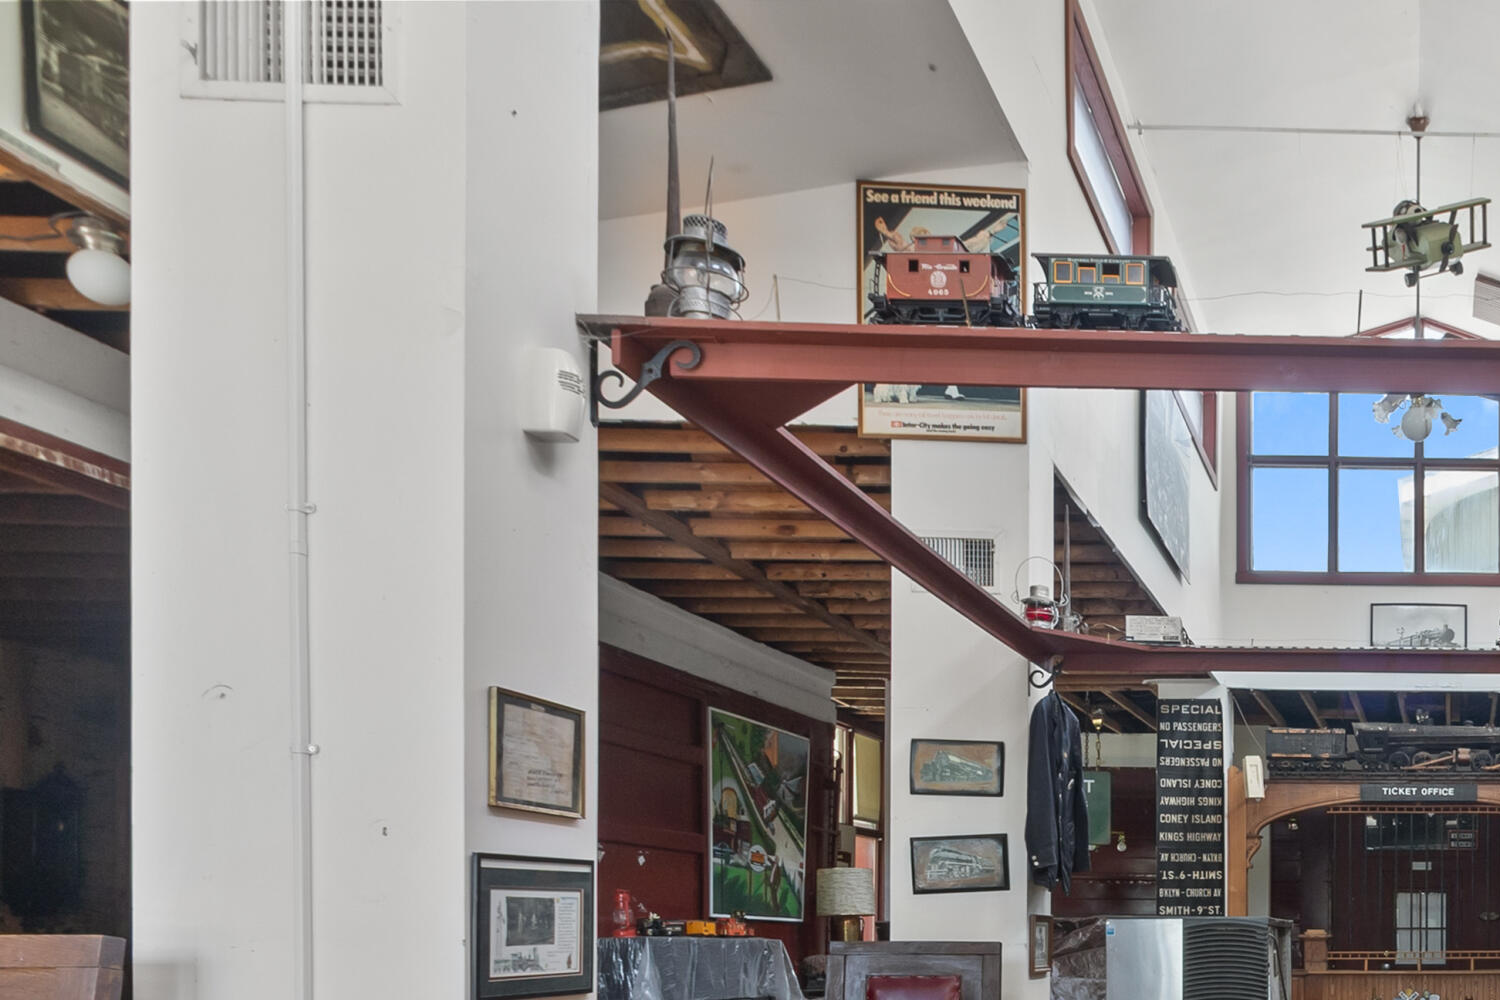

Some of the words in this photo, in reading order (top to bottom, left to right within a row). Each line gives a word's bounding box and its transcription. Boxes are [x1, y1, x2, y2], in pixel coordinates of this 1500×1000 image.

[866, 190, 889, 203] See
[891, 194, 899, 203] a
[901, 190, 937, 204] friend
[939, 192, 961, 206] this
[963, 195, 1016, 209] weekend
[1160, 704, 1222, 714] SPECIAL
[1160, 722, 1170, 732] NO
[1173, 722, 1222, 732] PASSENGERS
[1160, 740, 1222, 750] SPECIAL
[1160, 757, 1209, 767] PASSENGERS
[1212, 757, 1222, 767] NO
[1160, 778, 1191, 788] ISLAND
[1194, 778, 1222, 788] CONEY
[1382, 787, 1417, 797] TICKET
[1421, 788, 1455, 797] OFFICE
[1160, 797, 1195, 806] HIGHWAY
[1198, 797, 1222, 806] KINGS
[1160, 814, 1189, 824] CONEY
[1192, 814, 1222, 824] ISLAND
[1159, 832, 1184, 842] KINGS
[1187, 832, 1222, 842] HIGHWAY
